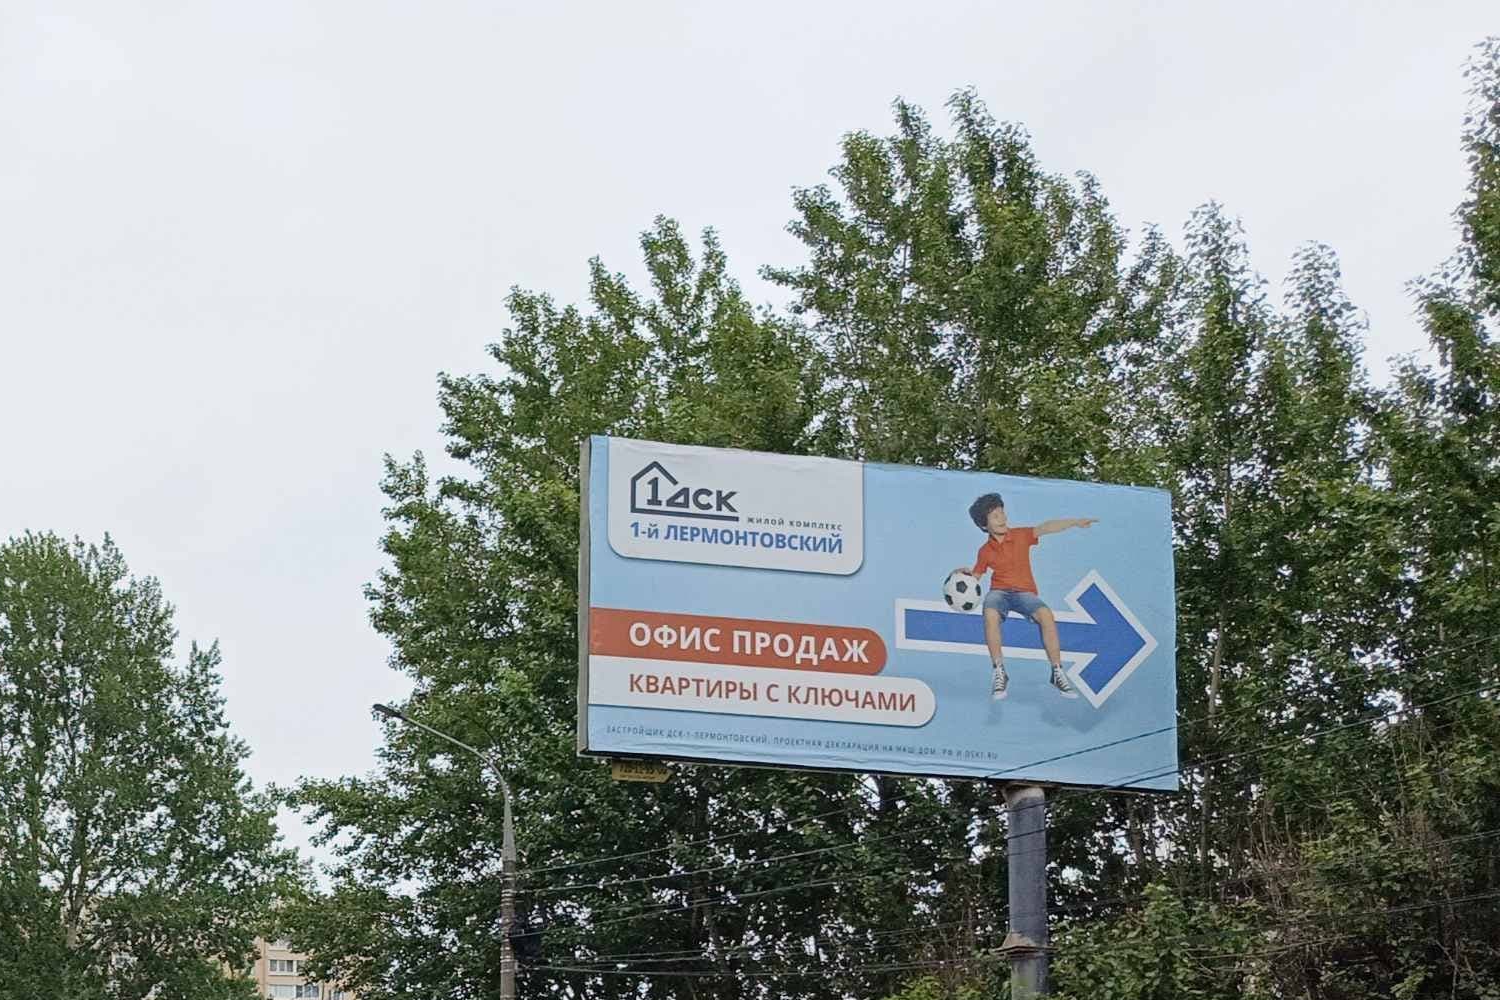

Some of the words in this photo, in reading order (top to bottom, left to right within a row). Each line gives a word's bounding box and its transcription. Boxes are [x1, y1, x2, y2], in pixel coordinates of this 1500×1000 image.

[663, 524, 843, 554] ЛЕРМОНТОВСКИЙ
[628, 622, 721, 653] ОФИС
[732, 630, 870, 666] ПРОДАЖ
[629, 673, 758, 702] КВАРТИРЫ
[766, 683, 779, 702] С
[787, 685, 917, 713] КЛЮЧАМИ
